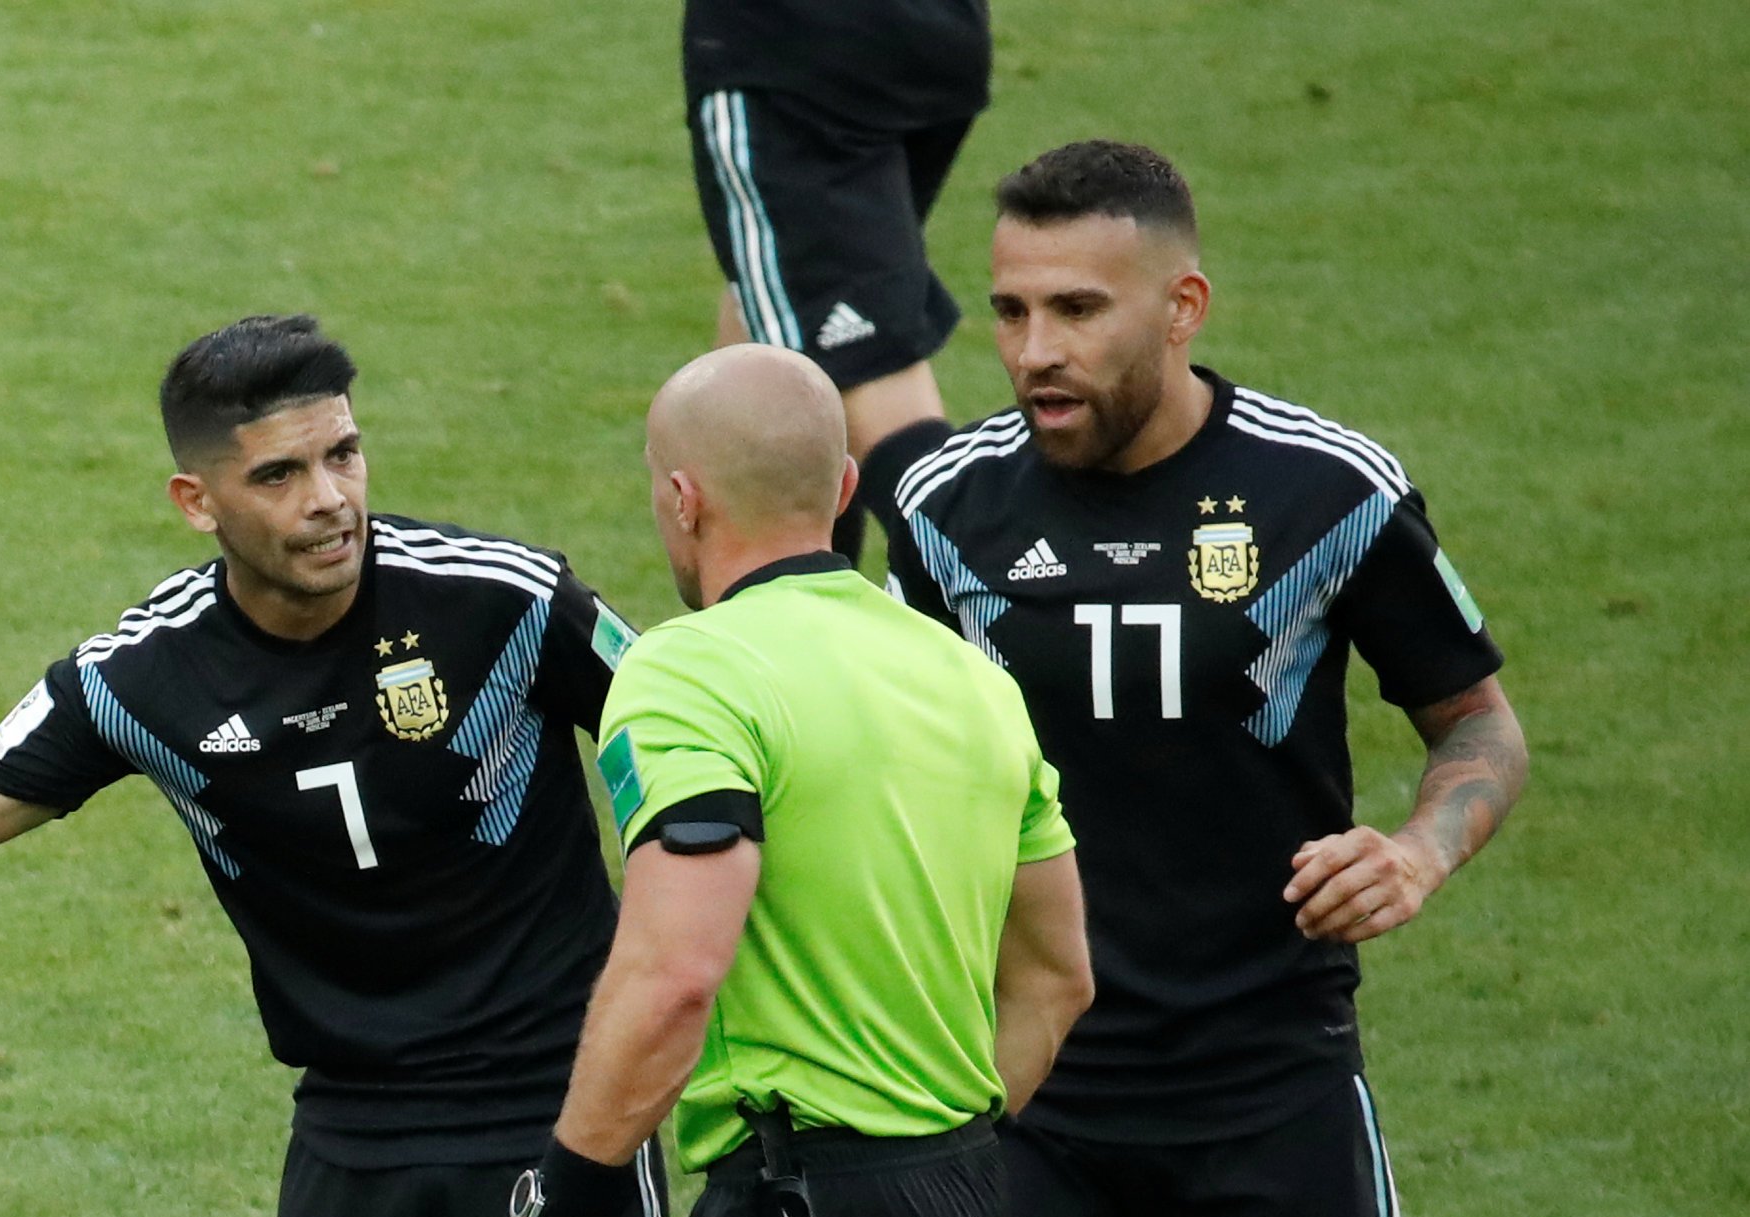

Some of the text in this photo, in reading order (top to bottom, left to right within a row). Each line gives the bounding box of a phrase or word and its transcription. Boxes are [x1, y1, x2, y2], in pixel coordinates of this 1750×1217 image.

[1007, 563, 1067, 581] adidas
[1206, 544, 1243, 579] AFA
[1074, 604, 1182, 719] 17
[396, 682, 431, 717] AFA
[199, 739, 261, 753] adidas
[295, 761, 379, 870] 7
